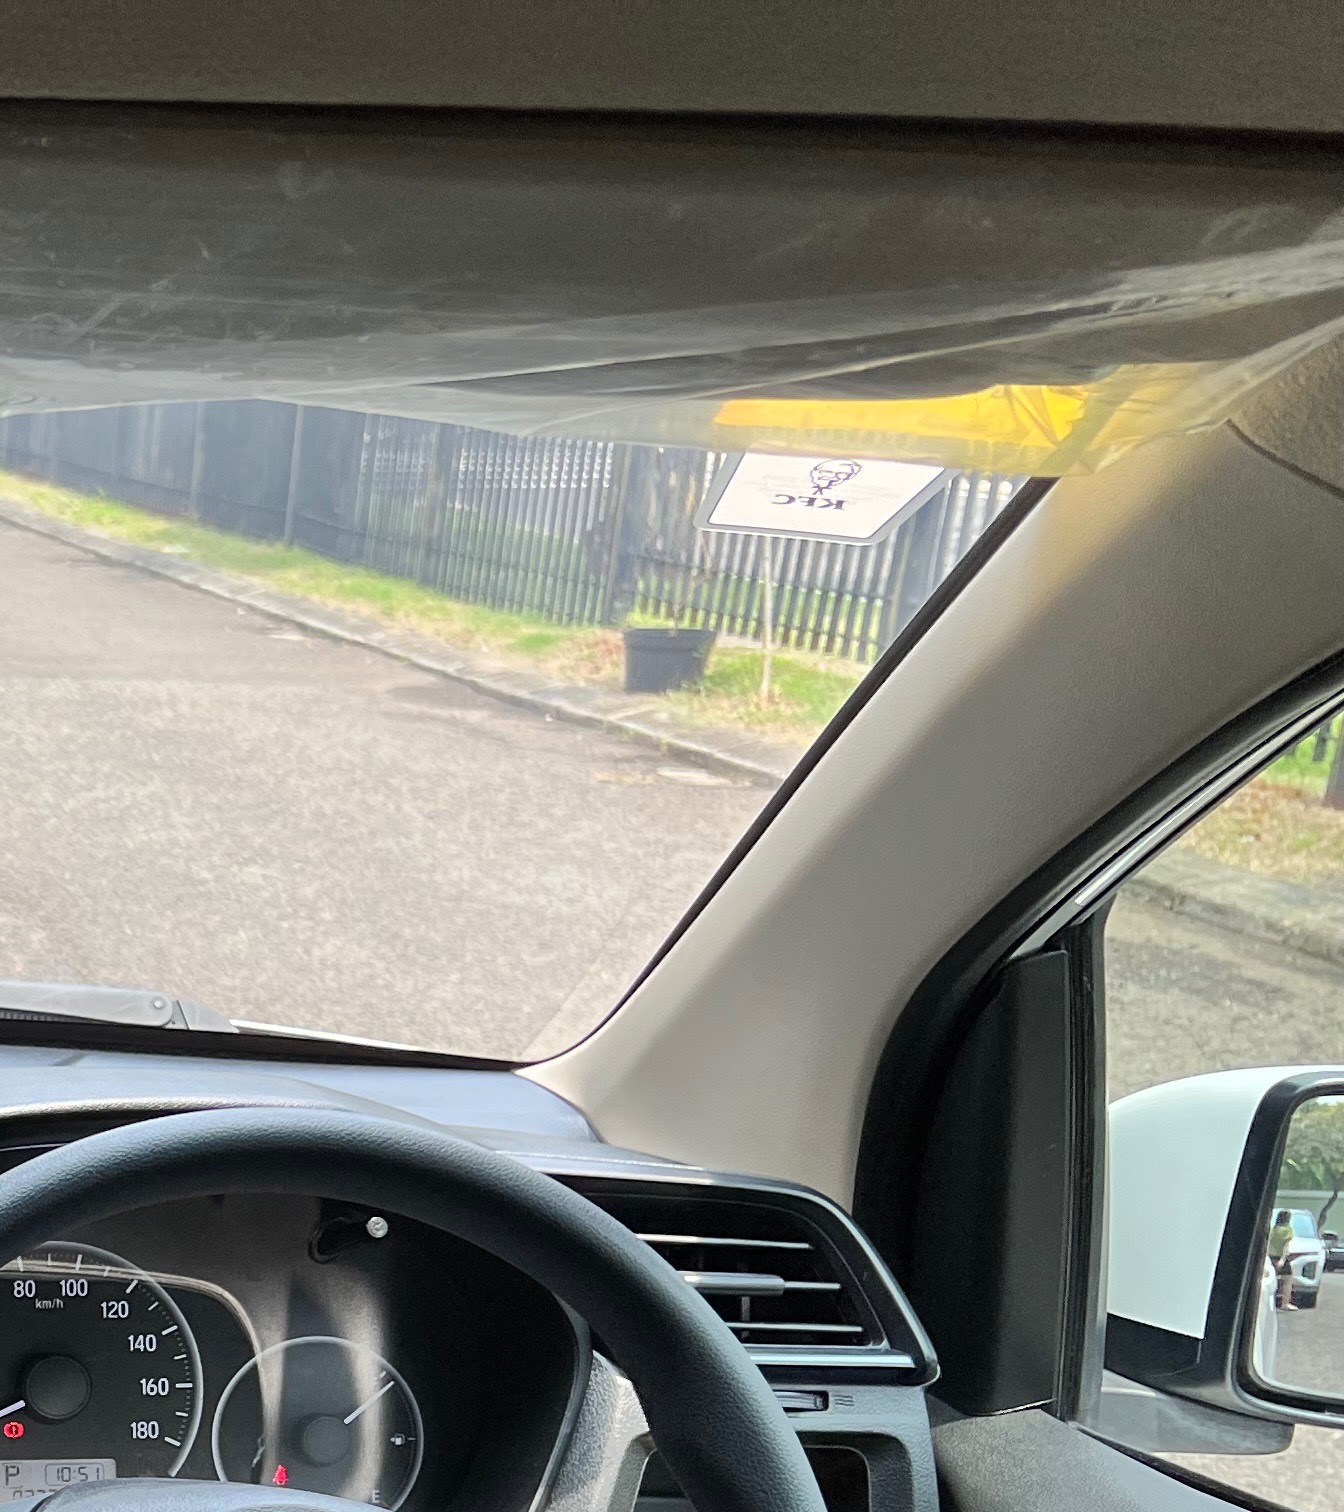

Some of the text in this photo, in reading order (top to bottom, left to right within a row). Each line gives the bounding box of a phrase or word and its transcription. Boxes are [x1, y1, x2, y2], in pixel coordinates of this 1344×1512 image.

[13, 1280, 36, 1298] 80
[59, 1279, 88, 1297] 100
[35, 1298, 64, 1310] km/h
[101, 1301, 129, 1319] 120
[127, 1334, 157, 1352] 140
[140, 1377, 170, 1396] 160
[130, 1421, 160, 1440] 180
[5, 1465, 20, 1486] P
